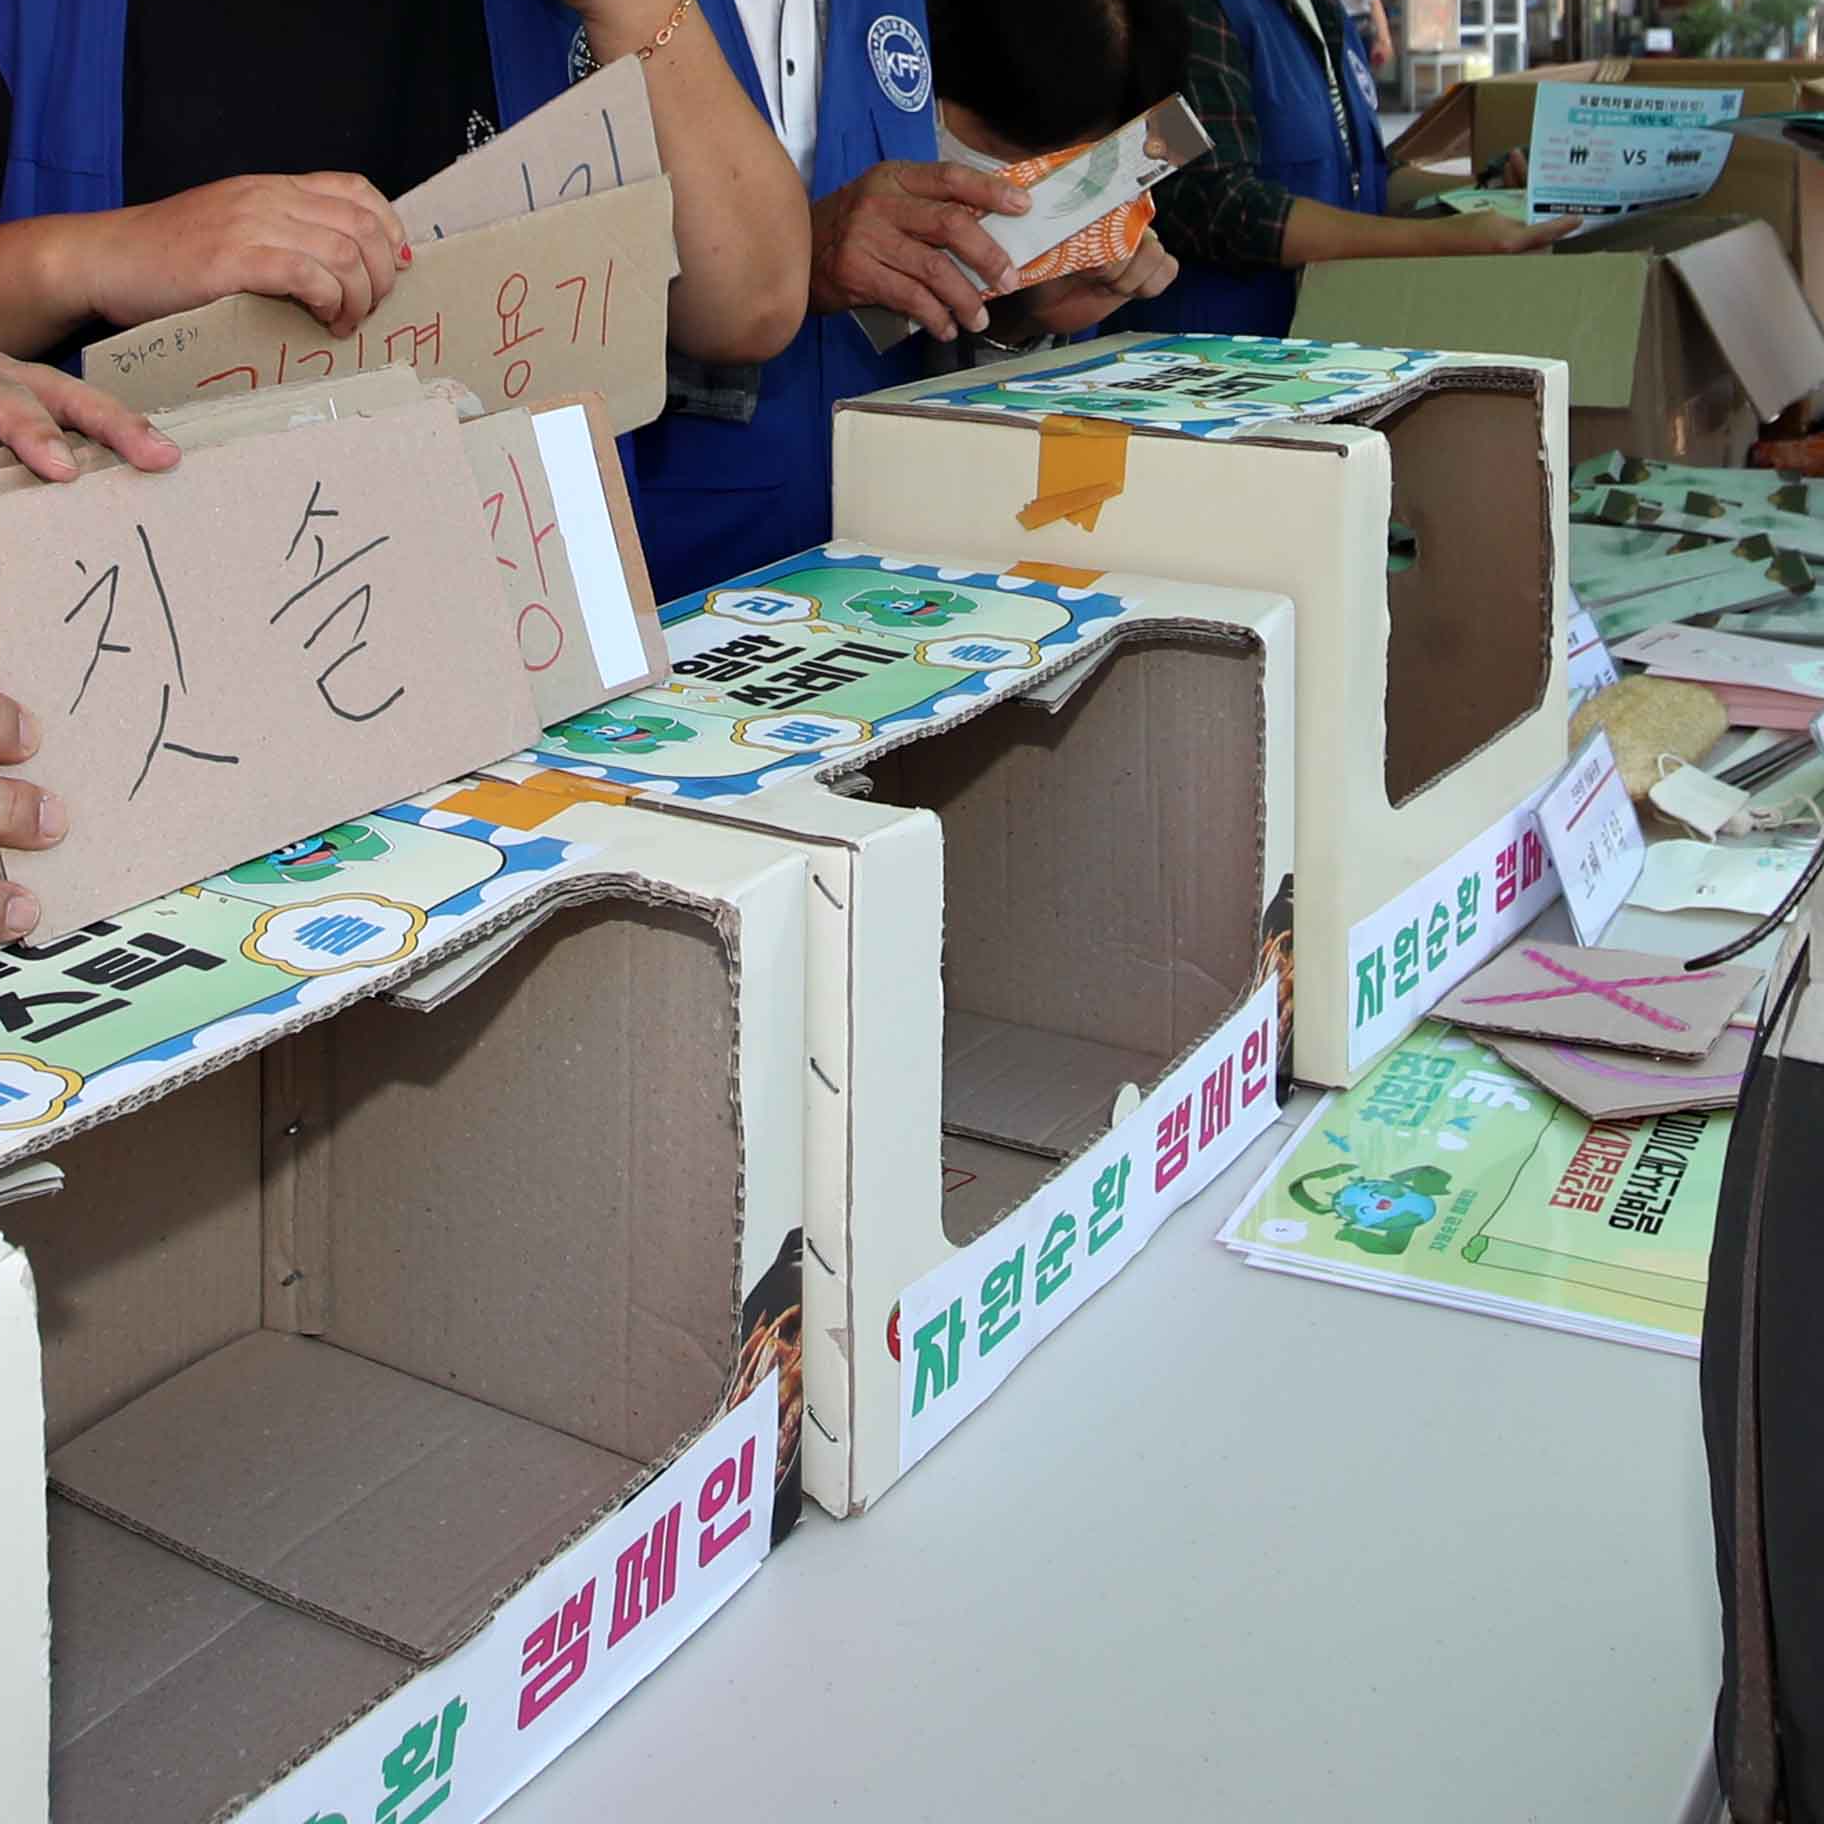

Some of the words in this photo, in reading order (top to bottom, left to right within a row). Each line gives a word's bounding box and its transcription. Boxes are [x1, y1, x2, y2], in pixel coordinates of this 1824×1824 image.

[884, 50, 920, 79] KFF
[1623, 149, 1647, 165] VS
[64, 480, 406, 801] 칫솔
[670, 633, 807, 683] 일반
[726, 640, 911, 711] 쓰레기
[765, 719, 842, 746] 배
[1355, 871, 1481, 1030] 자원순환
[1495, 828, 1554, 914] 캠페
[1360, 1049, 1457, 1130] 친환경
[910, 1152, 1133, 1420] 자원순환
[1154, 1014, 1270, 1195] 캠페인
[516, 1433, 756, 1732] 캠페인
